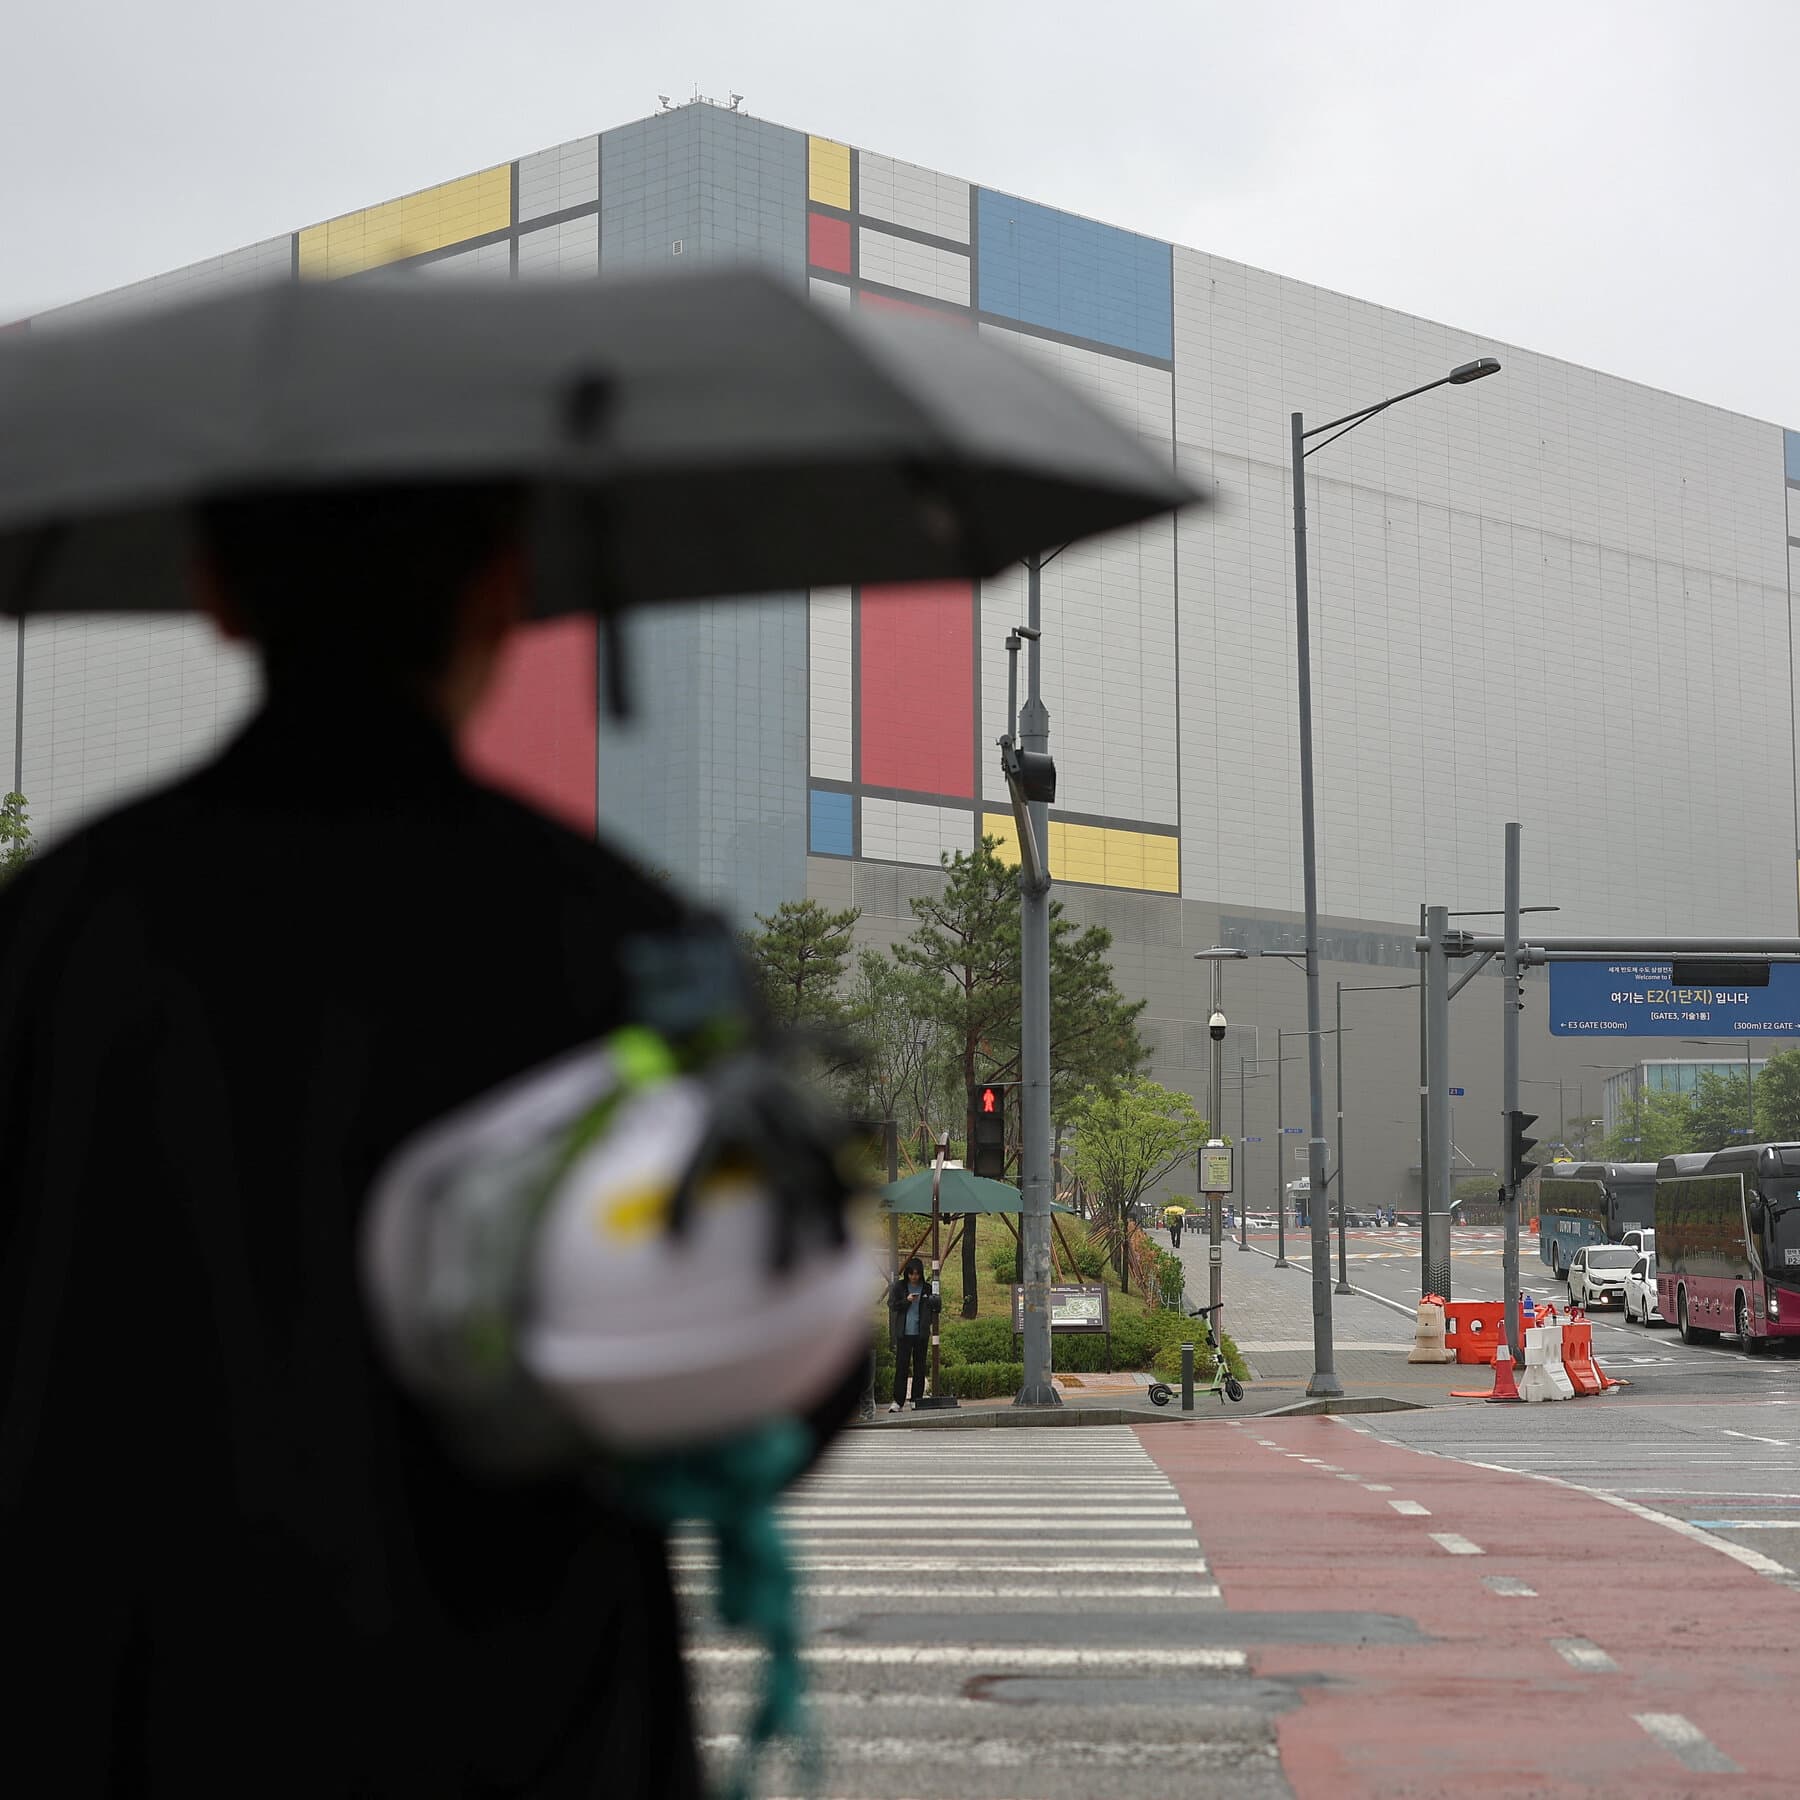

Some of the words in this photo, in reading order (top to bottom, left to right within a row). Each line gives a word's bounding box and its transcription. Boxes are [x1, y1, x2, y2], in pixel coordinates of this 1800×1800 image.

[1611, 992, 1644, 1004] 여기는
[1647, 989, 1712, 1005] E2(1단지)
[1715, 992, 1749, 1004] 입니다
[1651, 1012, 1680, 1021] [GATE3,
[1568, 1021, 1578, 1029] E3
[1579, 1021, 1599, 1029] GATE
[1600, 1021, 1628, 1030] (300m)
[1734, 1022, 1762, 1030] (300m)
[1763, 1022, 1772, 1030] E2
[1774, 1022, 1793, 1030] GATE
